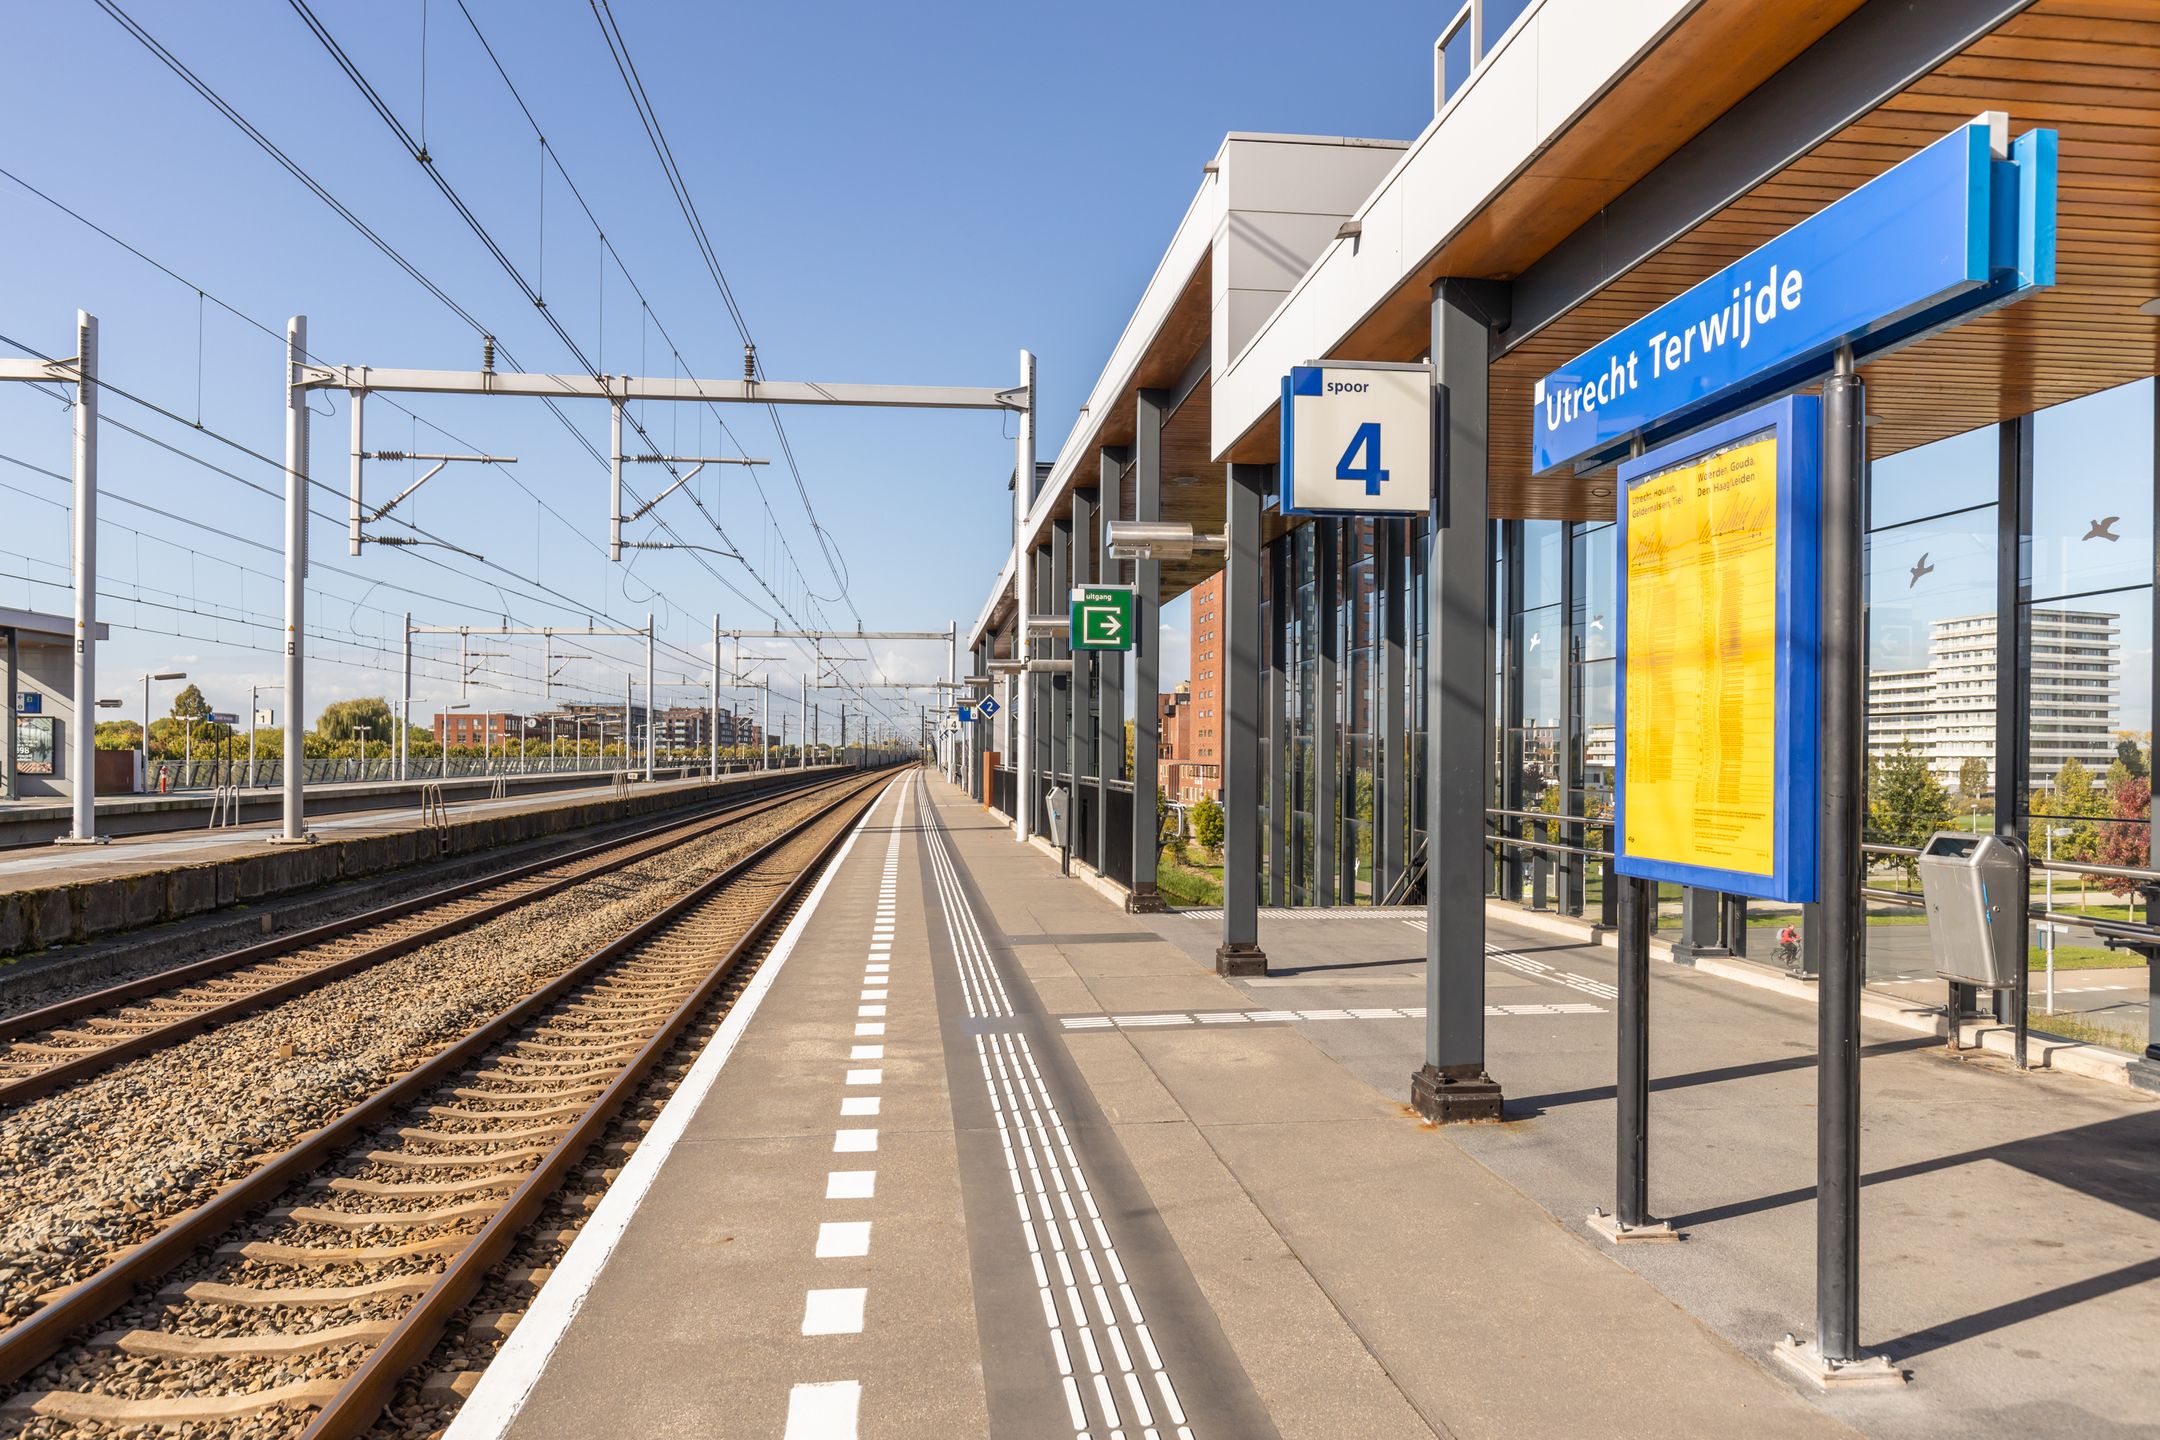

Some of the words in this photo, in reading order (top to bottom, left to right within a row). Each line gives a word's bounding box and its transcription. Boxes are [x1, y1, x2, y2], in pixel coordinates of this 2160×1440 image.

[1546, 350, 1638, 431] Utrecht
[1649, 265, 1803, 378] Terwijde
[1327, 381, 1369, 395] spoor
[1336, 422, 1390, 496] 4
[1697, 486, 1711, 497] Den
[1672, 494, 1684, 506] Tiel
[1086, 593, 1112, 602] uitgang
[986, 701, 994, 712] 2
[951, 721, 957, 729] 4
